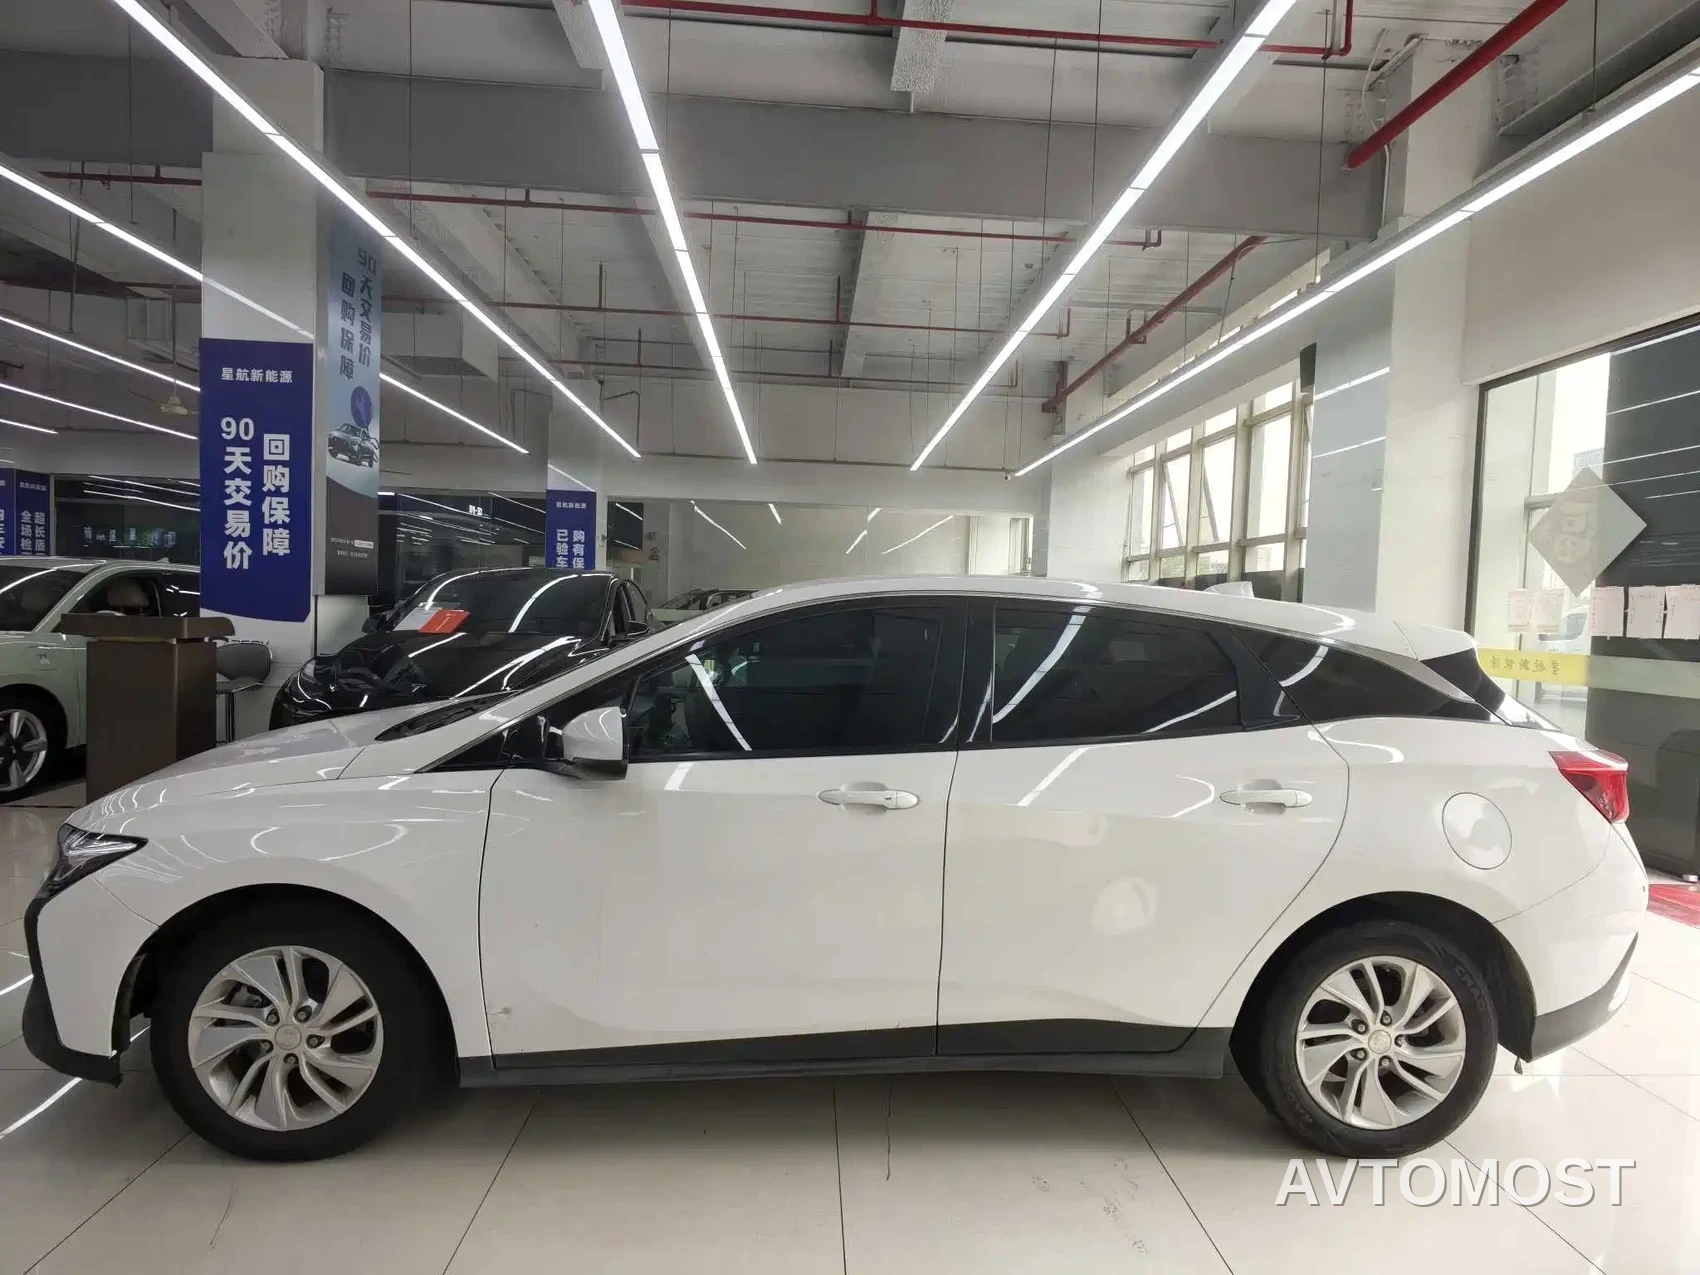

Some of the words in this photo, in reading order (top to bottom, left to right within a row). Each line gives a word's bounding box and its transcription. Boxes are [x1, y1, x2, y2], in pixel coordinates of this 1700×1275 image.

[340, 271, 355, 380] 回购保障
[357, 245, 378, 368] 90天交易价
[221, 367, 293, 384] 星航新能源
[21, 510, 32, 555] 全场检
[34, 511, 46, 555] 超长质
[220, 417, 255, 570] 90天交易价
[262, 433, 291, 556] 回购保障
